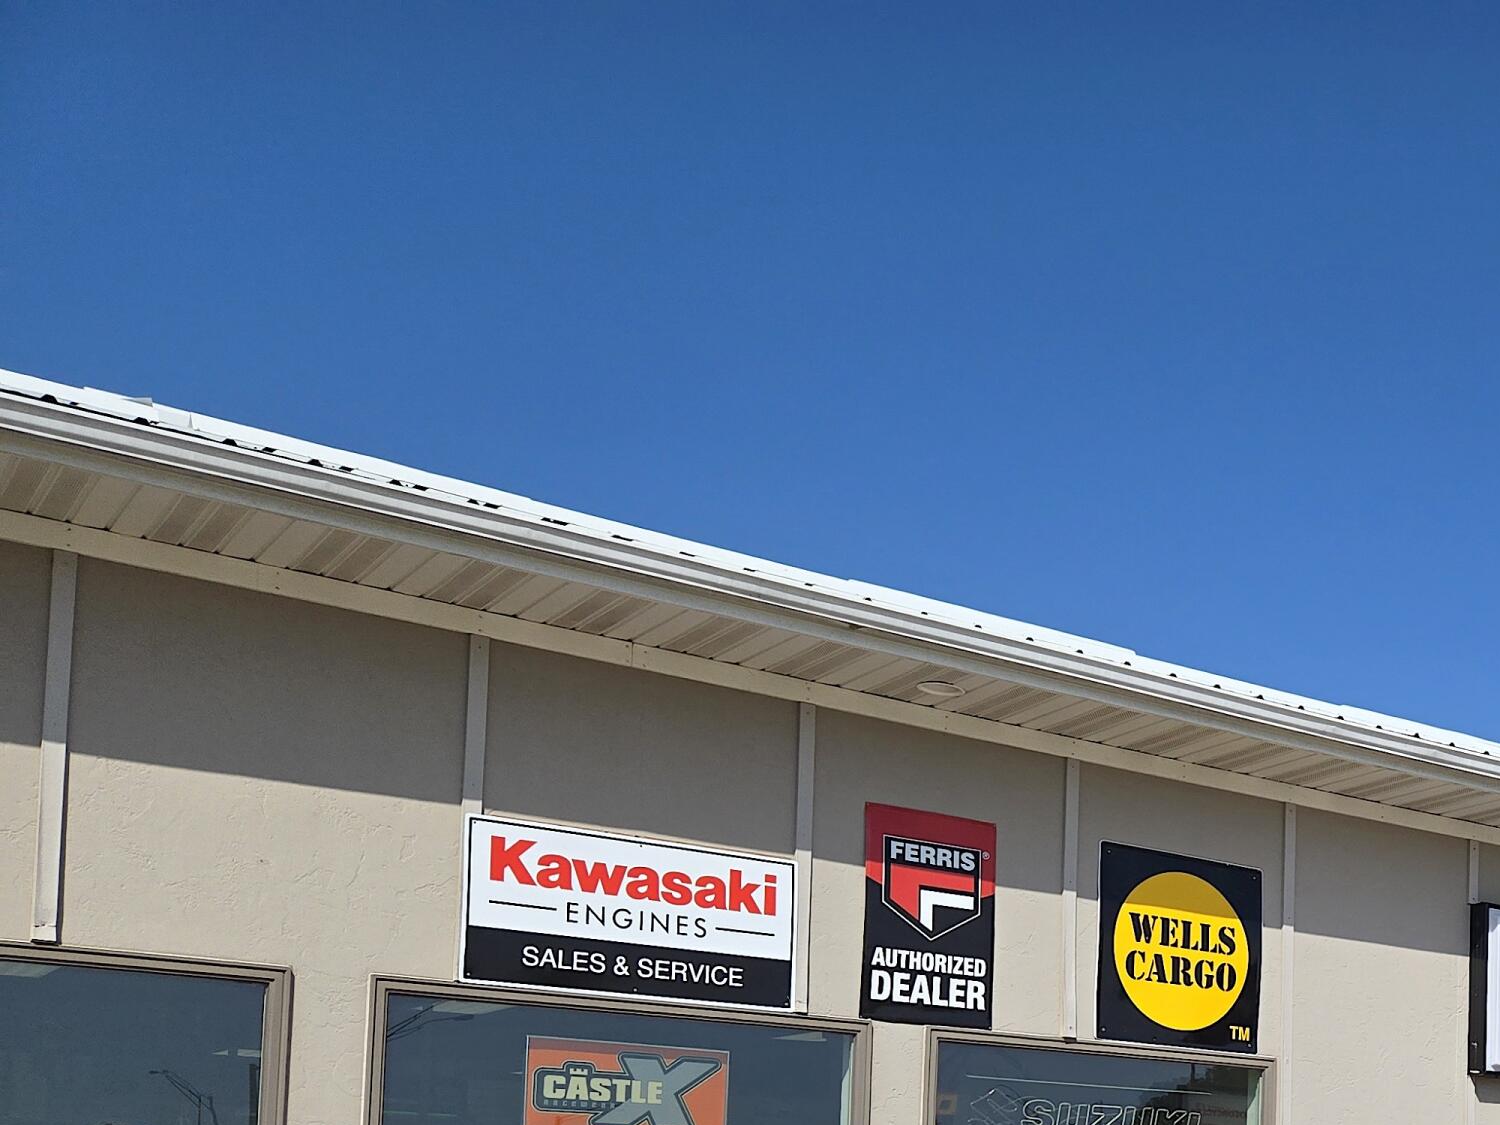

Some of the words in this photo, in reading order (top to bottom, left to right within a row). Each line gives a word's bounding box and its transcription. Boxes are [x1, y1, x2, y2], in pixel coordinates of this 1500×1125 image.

[488, 834, 777, 917] Kawasaki
[890, 840, 975, 872] FERRIS
[566, 902, 707, 939] ENGINES
[1128, 911, 1237, 956] WELLS
[522, 945, 606, 974] SALES
[613, 954, 630, 974] &
[637, 957, 743, 987] SERVICE
[871, 946, 987, 978] AUTHORIZED
[1125, 949, 1237, 992] CARGO
[870, 969, 986, 1011] DEALER
[1229, 1025, 1250, 1042] TM
[543, 1071, 663, 1105] CASTLE
